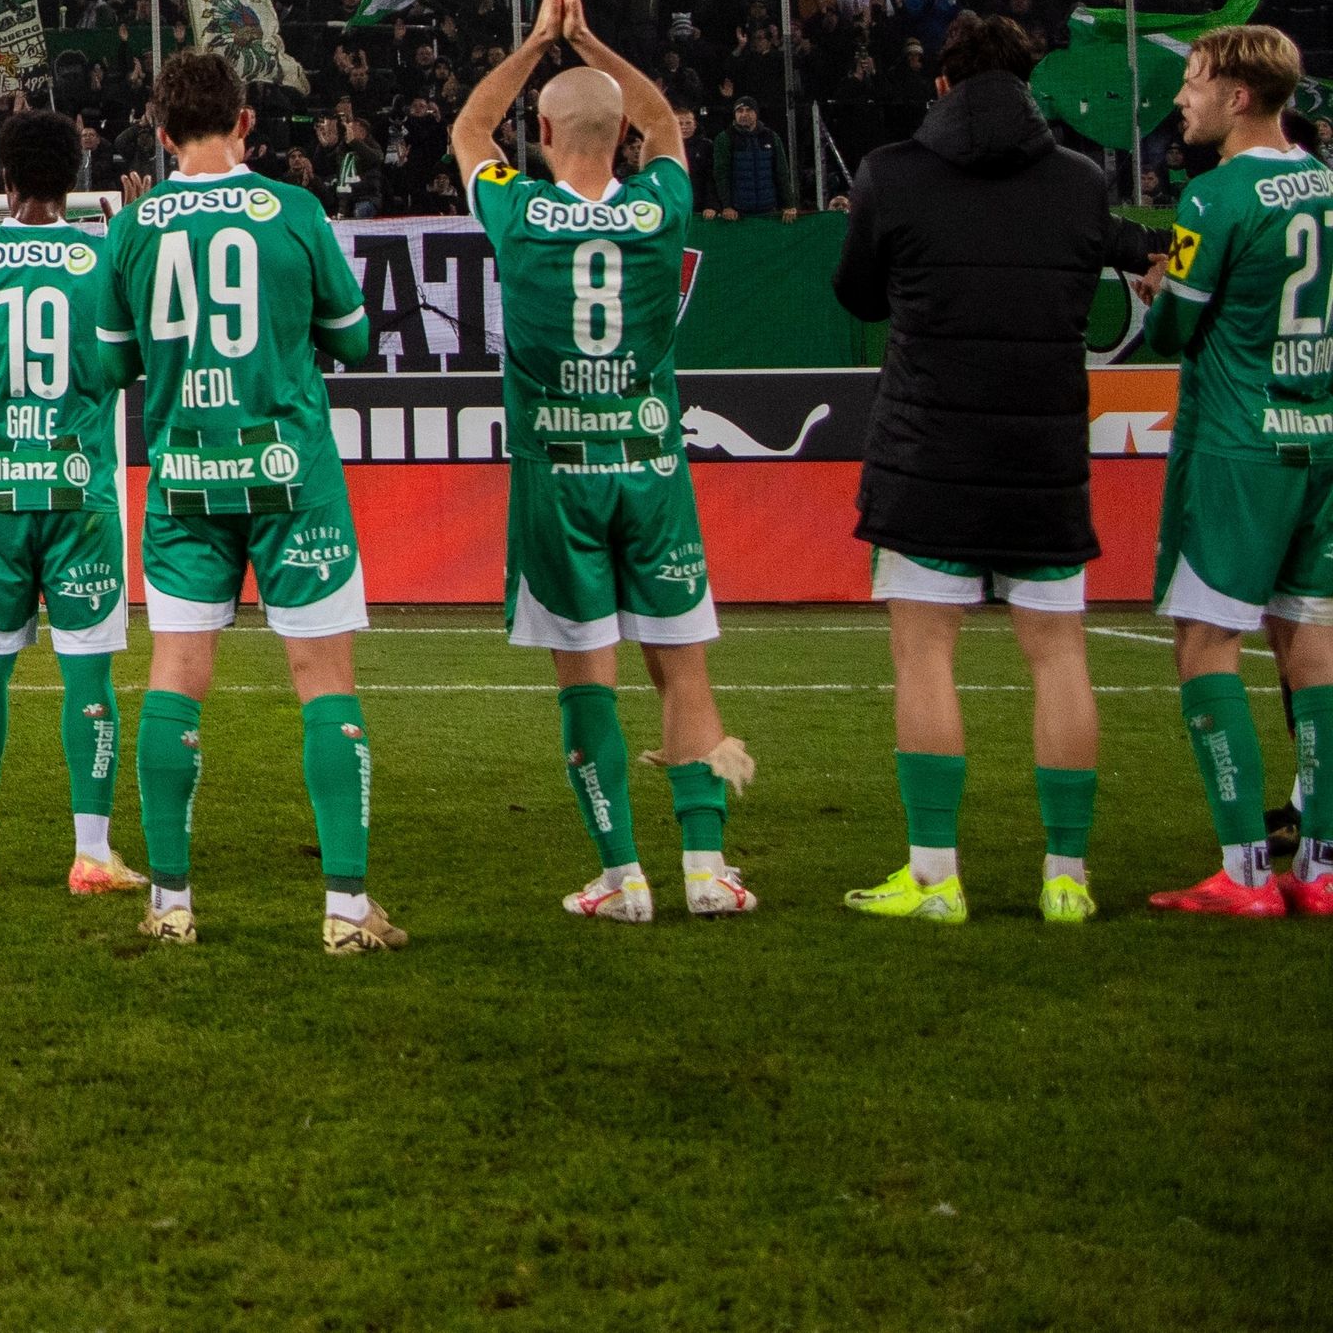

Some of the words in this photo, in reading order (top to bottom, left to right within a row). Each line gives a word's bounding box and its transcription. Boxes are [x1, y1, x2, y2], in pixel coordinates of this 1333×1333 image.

[139, 188, 242, 227] spusu
[529, 200, 629, 232] spusu
[150, 227, 259, 359] 49
[571, 239, 623, 357] 8
[560, 351, 637, 395] GRGIĆ
[6, 405, 58, 441] GALE
[534, 406, 634, 432] Allianz
[1262, 408, 1333, 435] Allian
[161, 452, 255, 481] Allianz
[293, 526, 341, 546] WIENER
[281, 544, 350, 568] ZUCKER
[58, 576, 119, 597] ZUCKER
[91, 720, 115, 779] easystaff
[578, 762, 613, 833] easystaff
